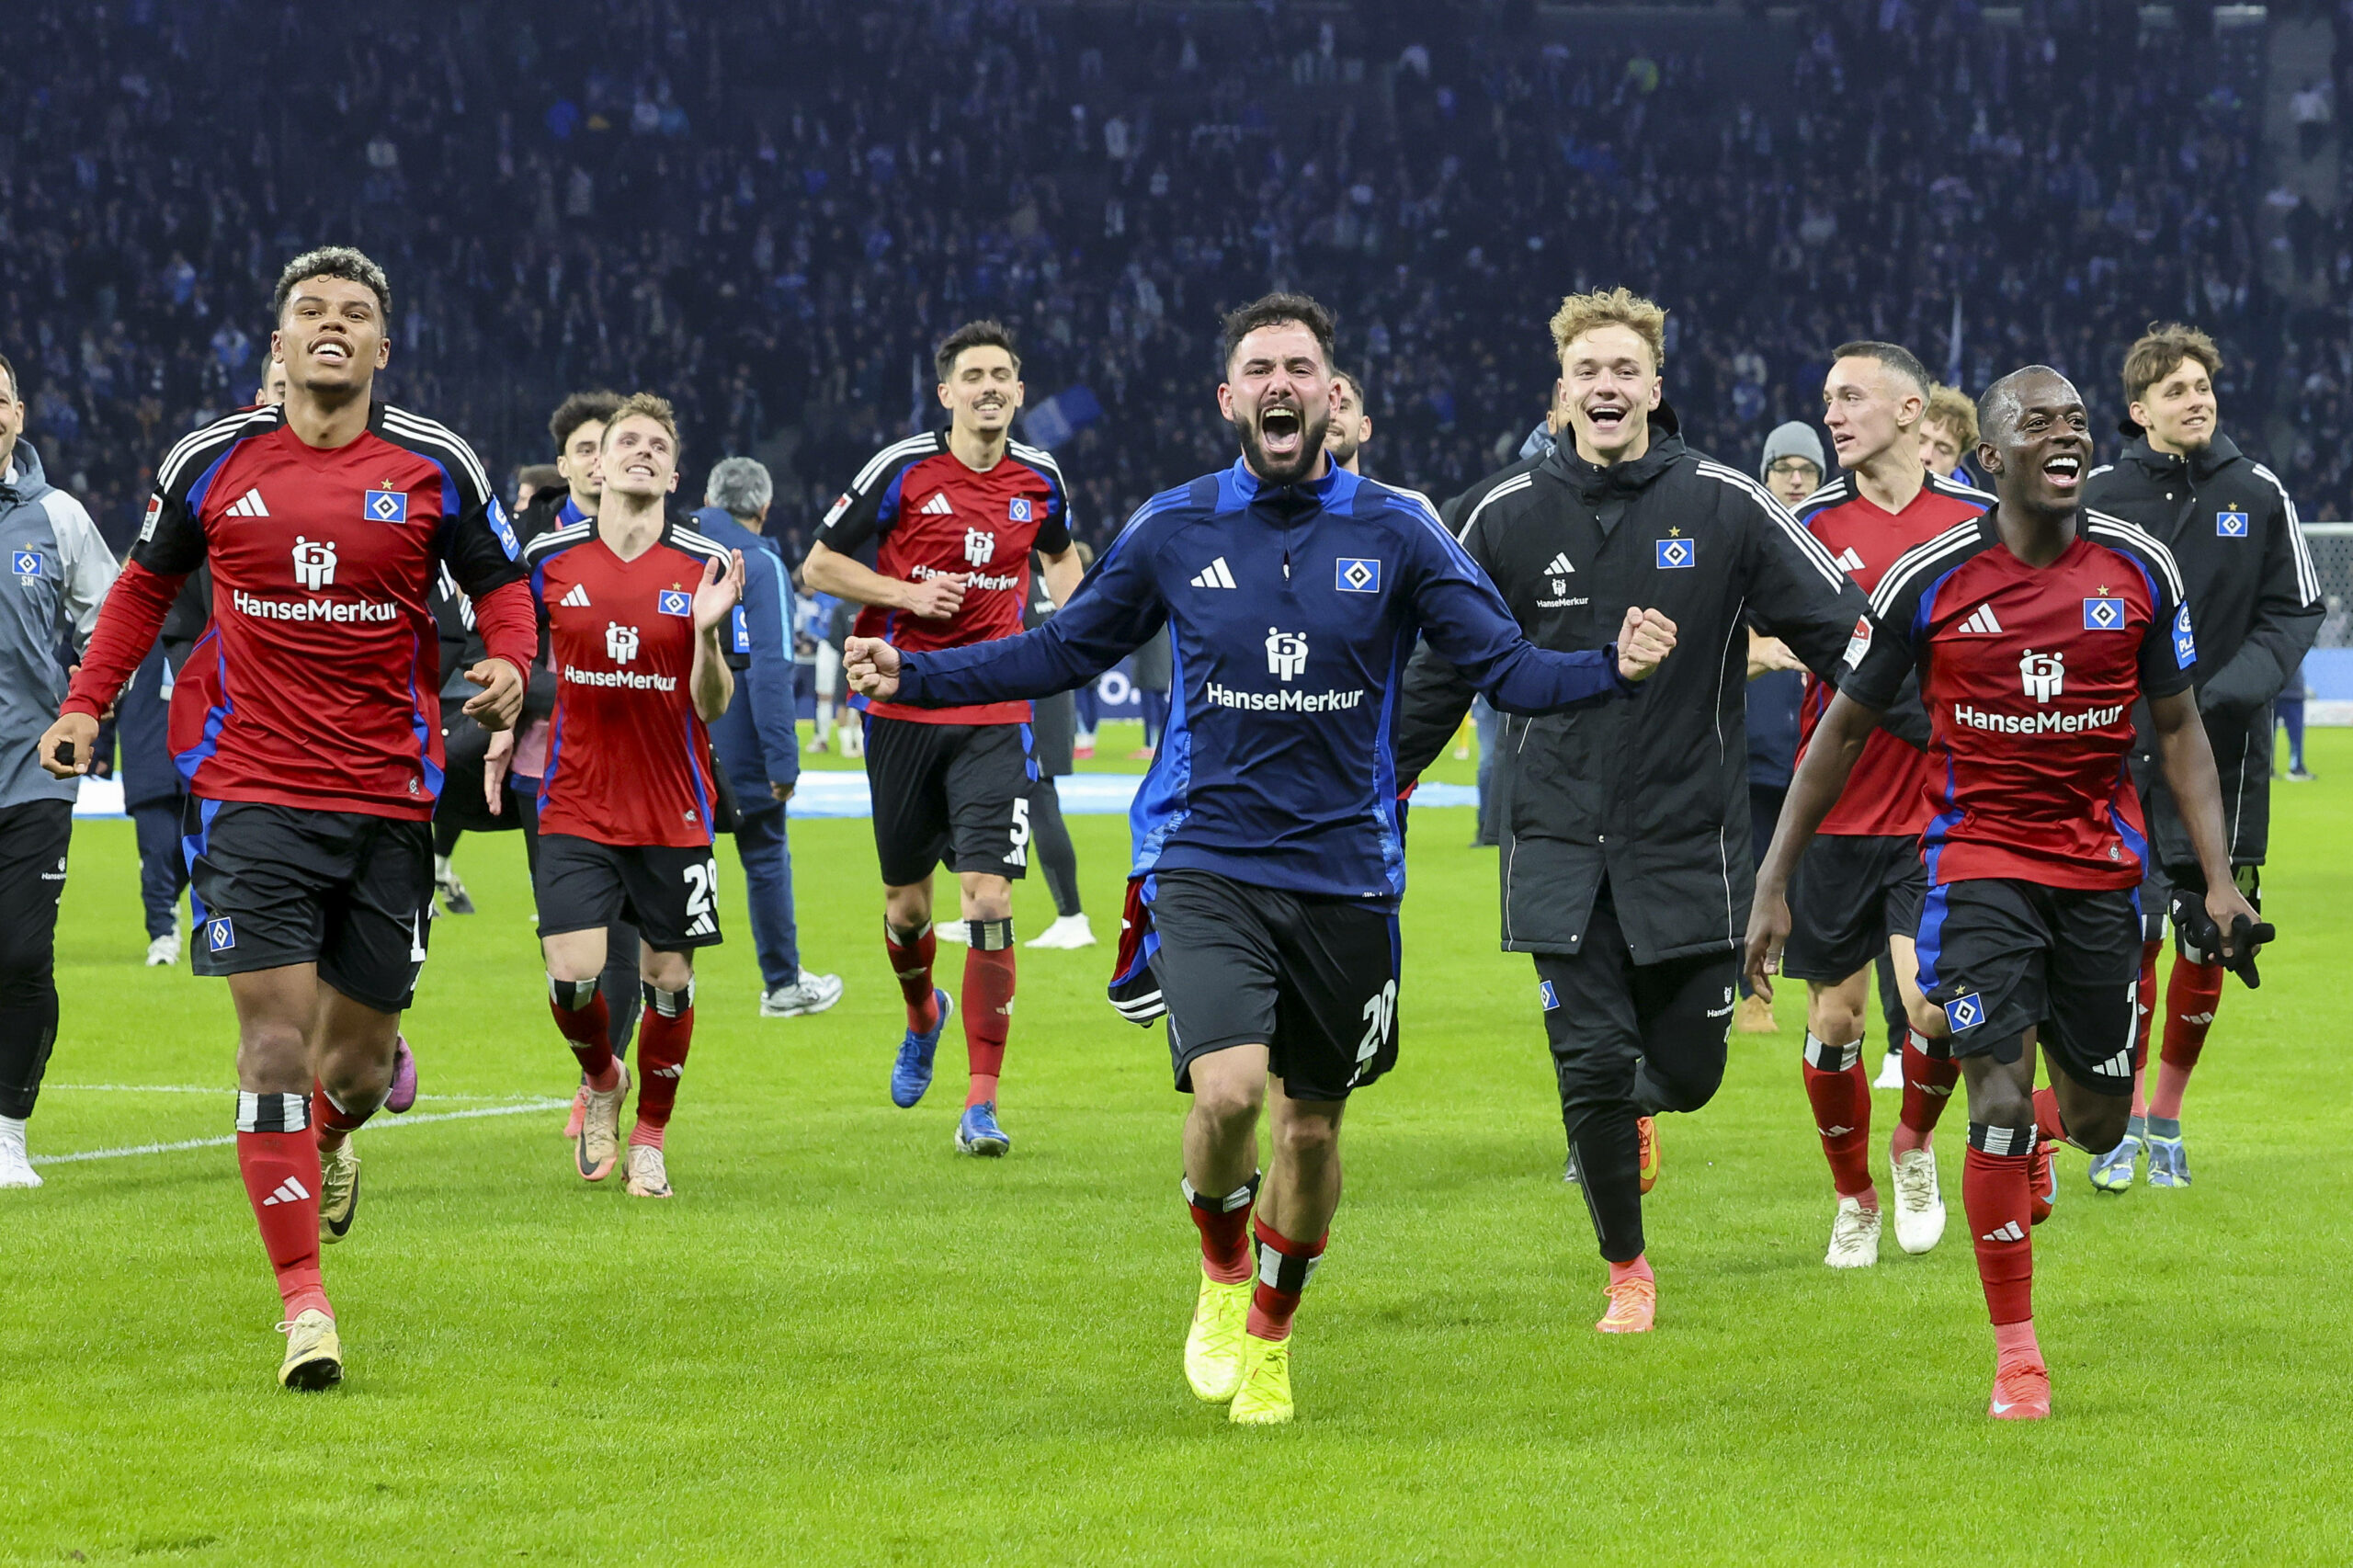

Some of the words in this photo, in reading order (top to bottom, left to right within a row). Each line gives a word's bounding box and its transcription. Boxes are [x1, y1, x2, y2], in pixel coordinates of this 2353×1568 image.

[21, 575, 35, 587] SH
[233, 588, 399, 623] HanseMerkur
[1536, 597, 1589, 608] HanseMerkur
[564, 664, 677, 692] HanseMerkur
[1206, 682, 1364, 713] HanseMerkur
[1954, 703, 2124, 735] HanseMerkur
[1009, 797, 1029, 846] 5
[1355, 979, 1396, 1063] 20
